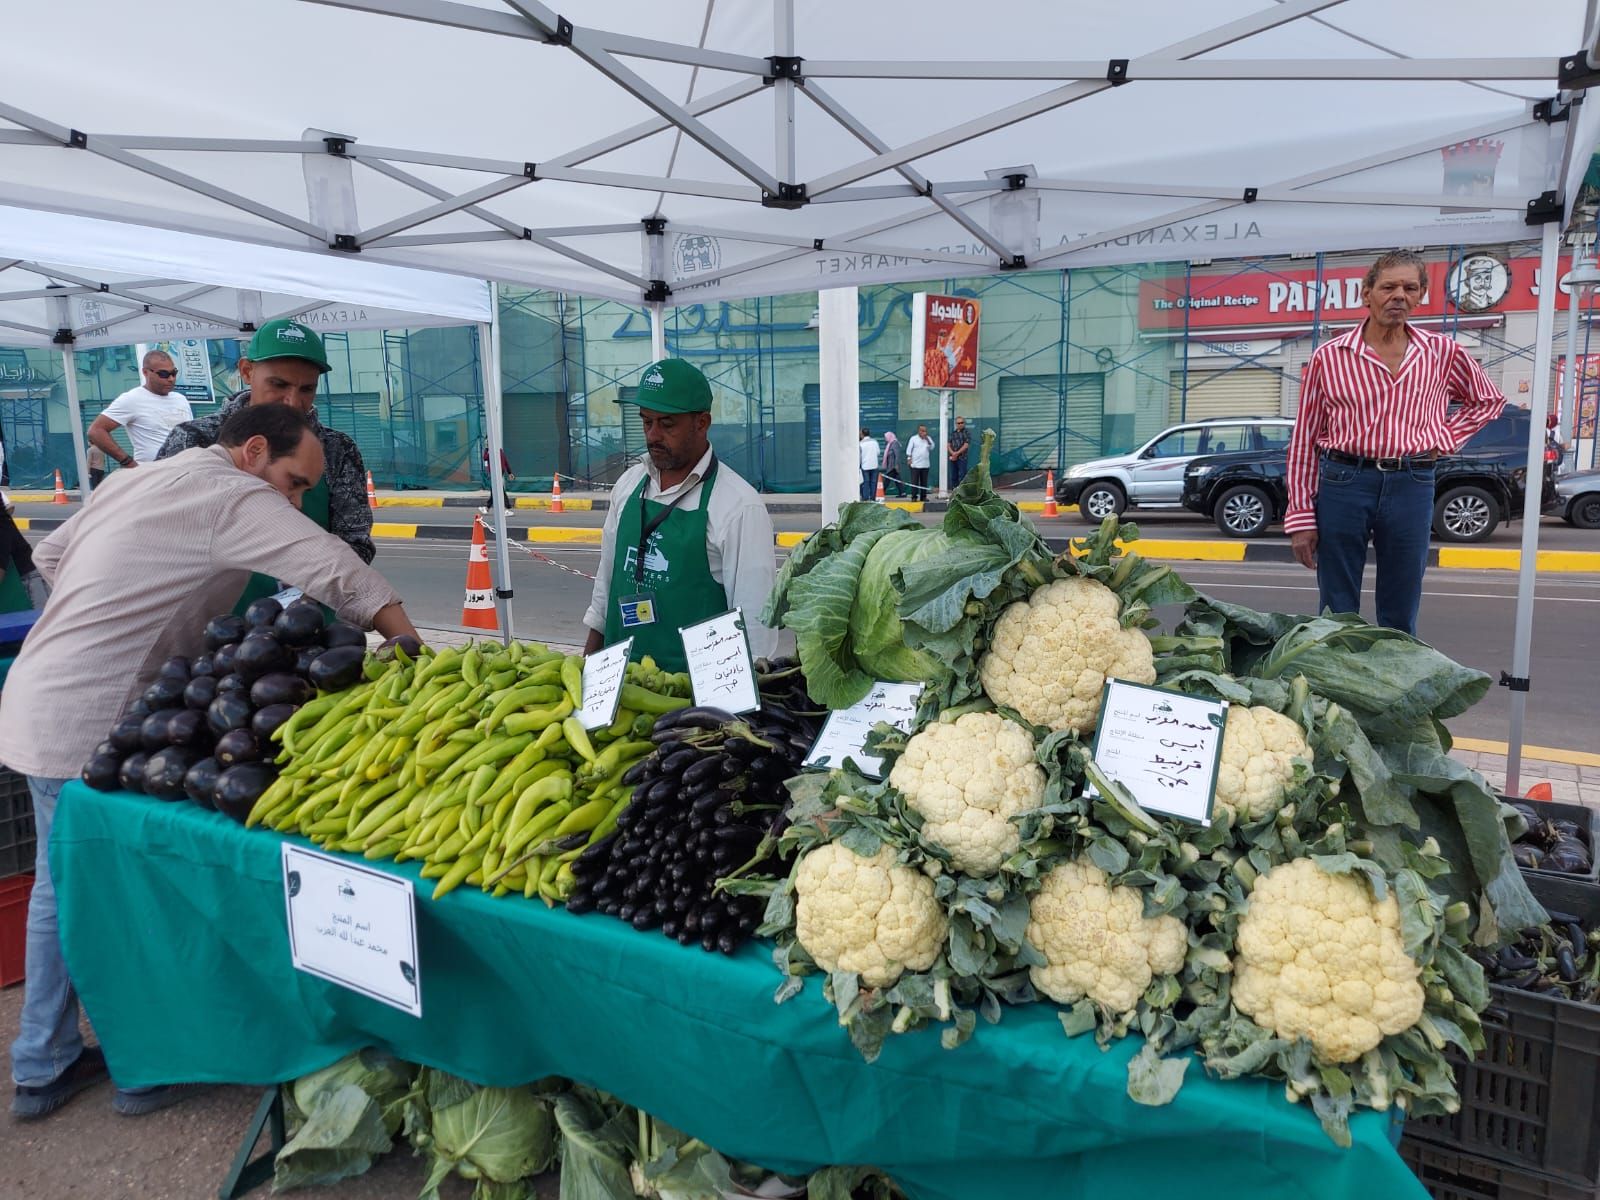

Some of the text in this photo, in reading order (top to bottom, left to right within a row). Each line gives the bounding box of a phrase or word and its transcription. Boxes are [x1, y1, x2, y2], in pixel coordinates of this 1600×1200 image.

[1153, 293, 1260, 310] The Original Recipe
[1204, 342, 1251, 354] JUICES
